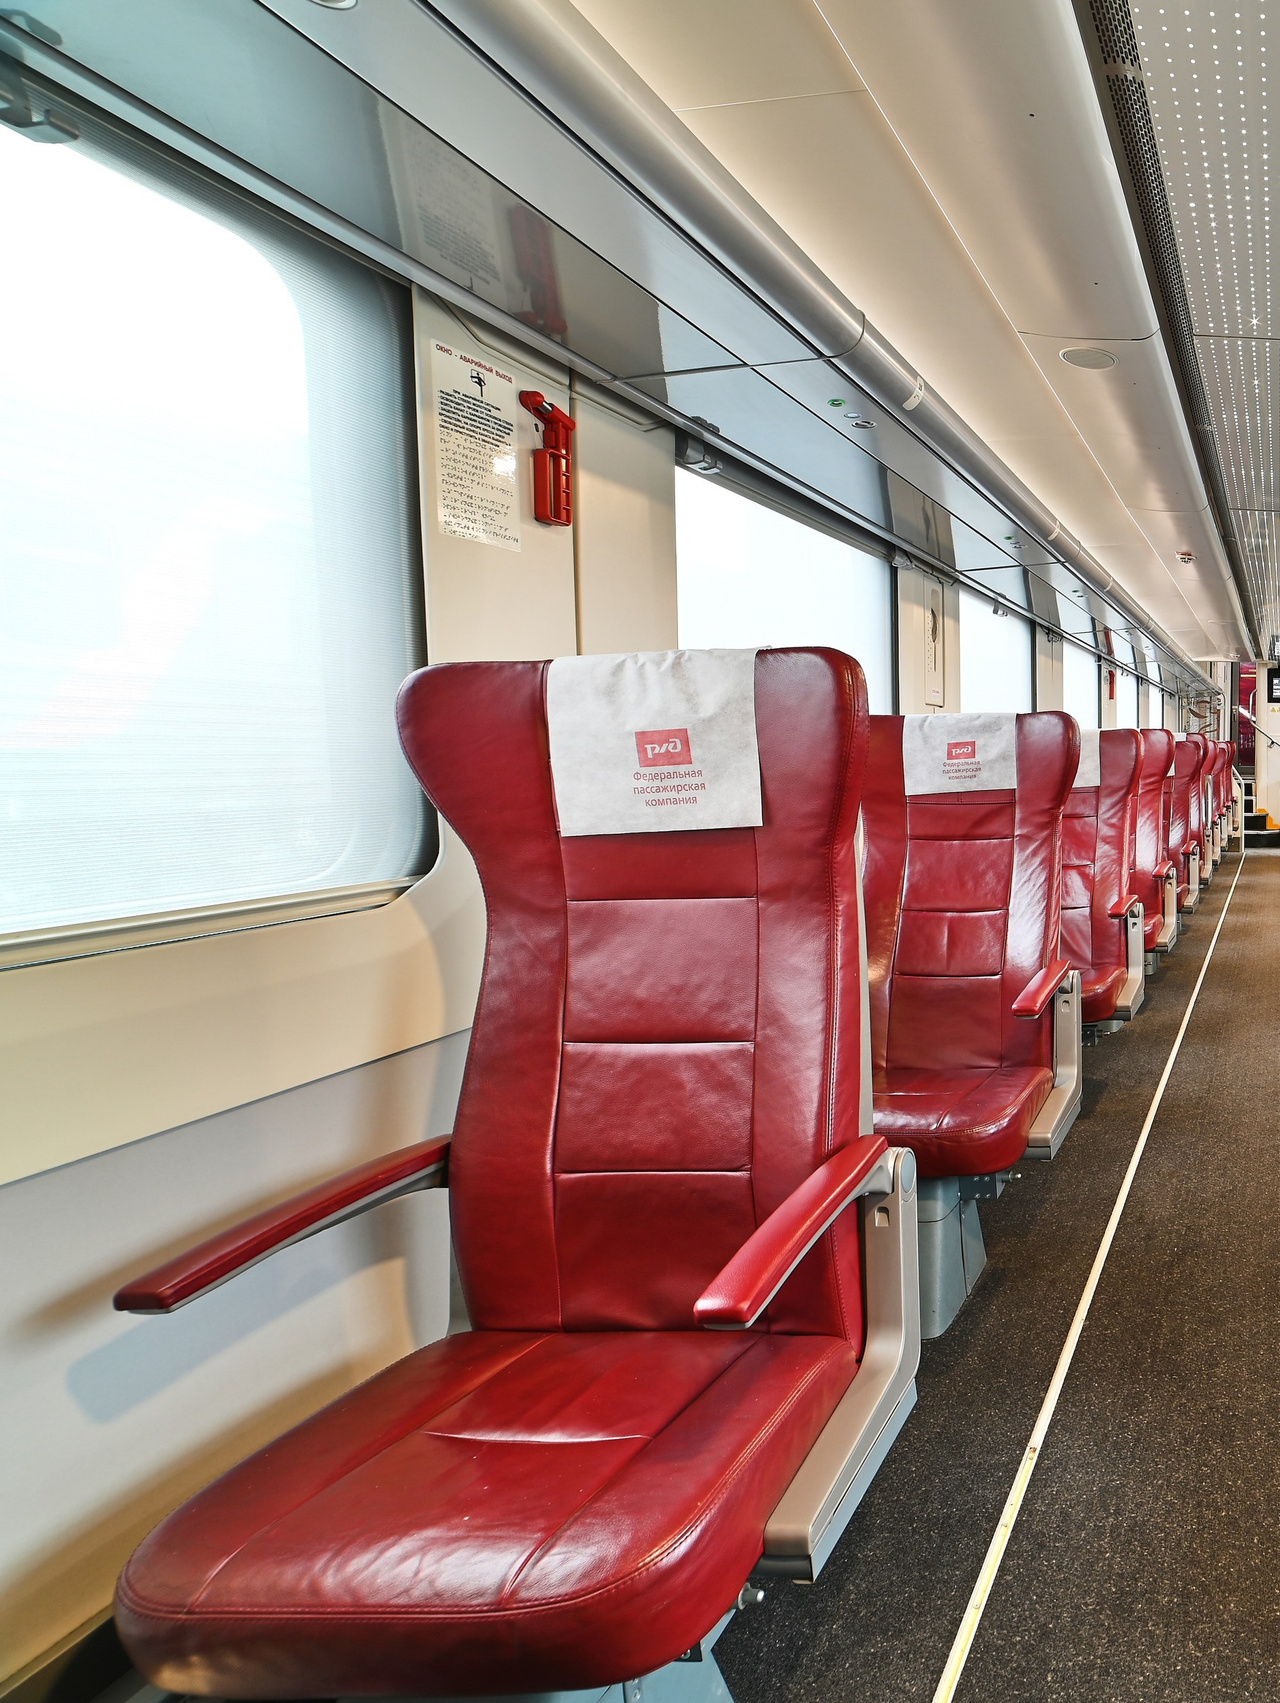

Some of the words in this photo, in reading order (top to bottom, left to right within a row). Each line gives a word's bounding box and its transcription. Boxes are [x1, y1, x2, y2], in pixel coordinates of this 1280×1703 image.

[435, 343, 453, 355] ОКНО
[459, 354, 494, 374] АВАРИЙНЫЙ
[495, 370, 513, 384] ВЫХОД
[633, 769, 703, 782] Федеральная
[633, 781, 706, 795] пассажирская
[644, 796, 698, 807] компания
